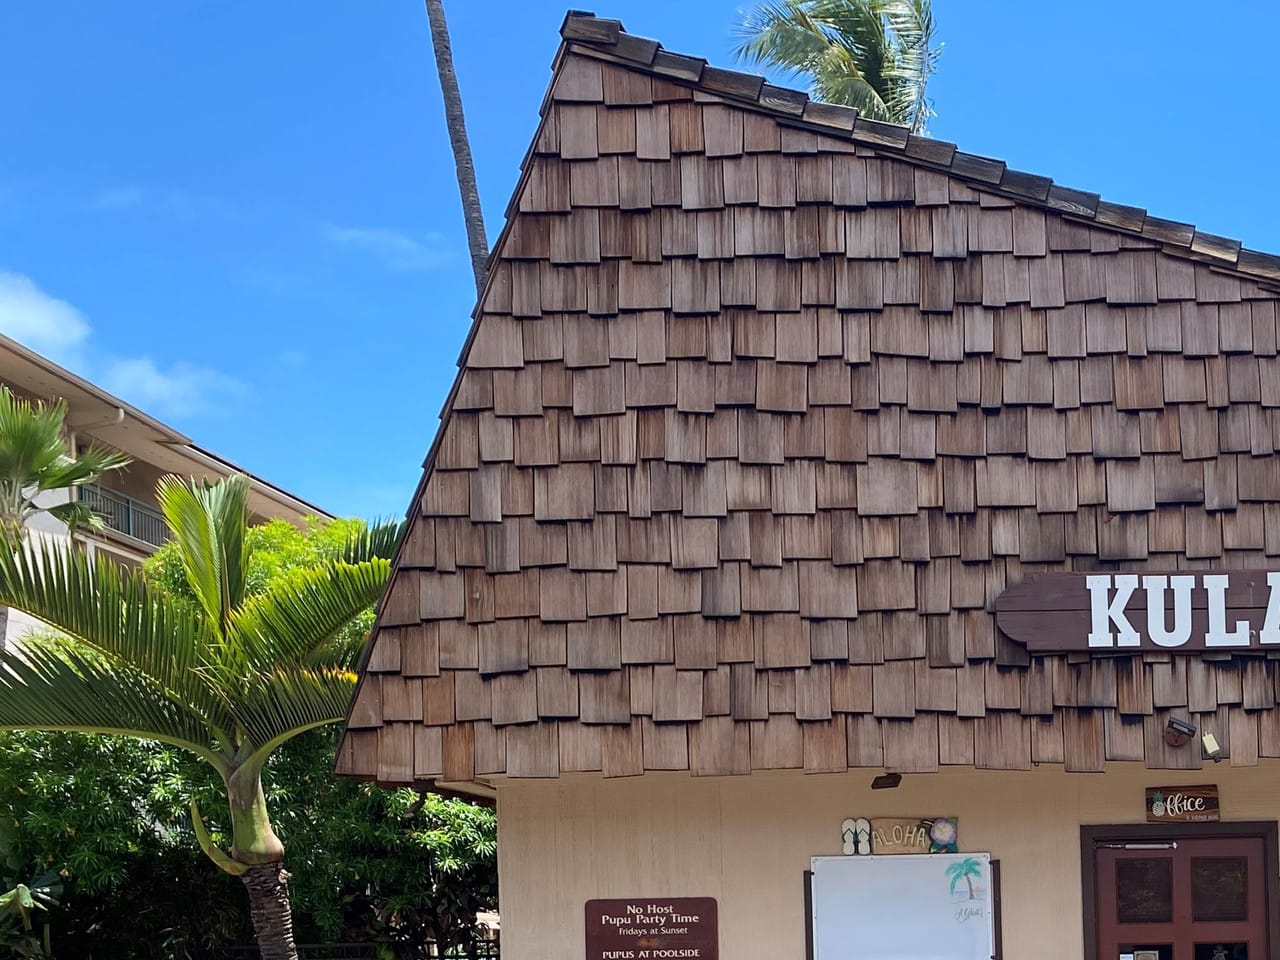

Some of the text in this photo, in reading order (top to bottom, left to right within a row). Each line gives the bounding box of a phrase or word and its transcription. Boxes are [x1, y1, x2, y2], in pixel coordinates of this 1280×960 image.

[872, 825, 926, 851] ALOHA
[626, 904, 674, 914] No Host
[601, 913, 700, 927] Pupu Party Time
[619, 926, 688, 937] Fridays at Sunset
[602, 949, 700, 959] PUPUS AT POOLSIDE
